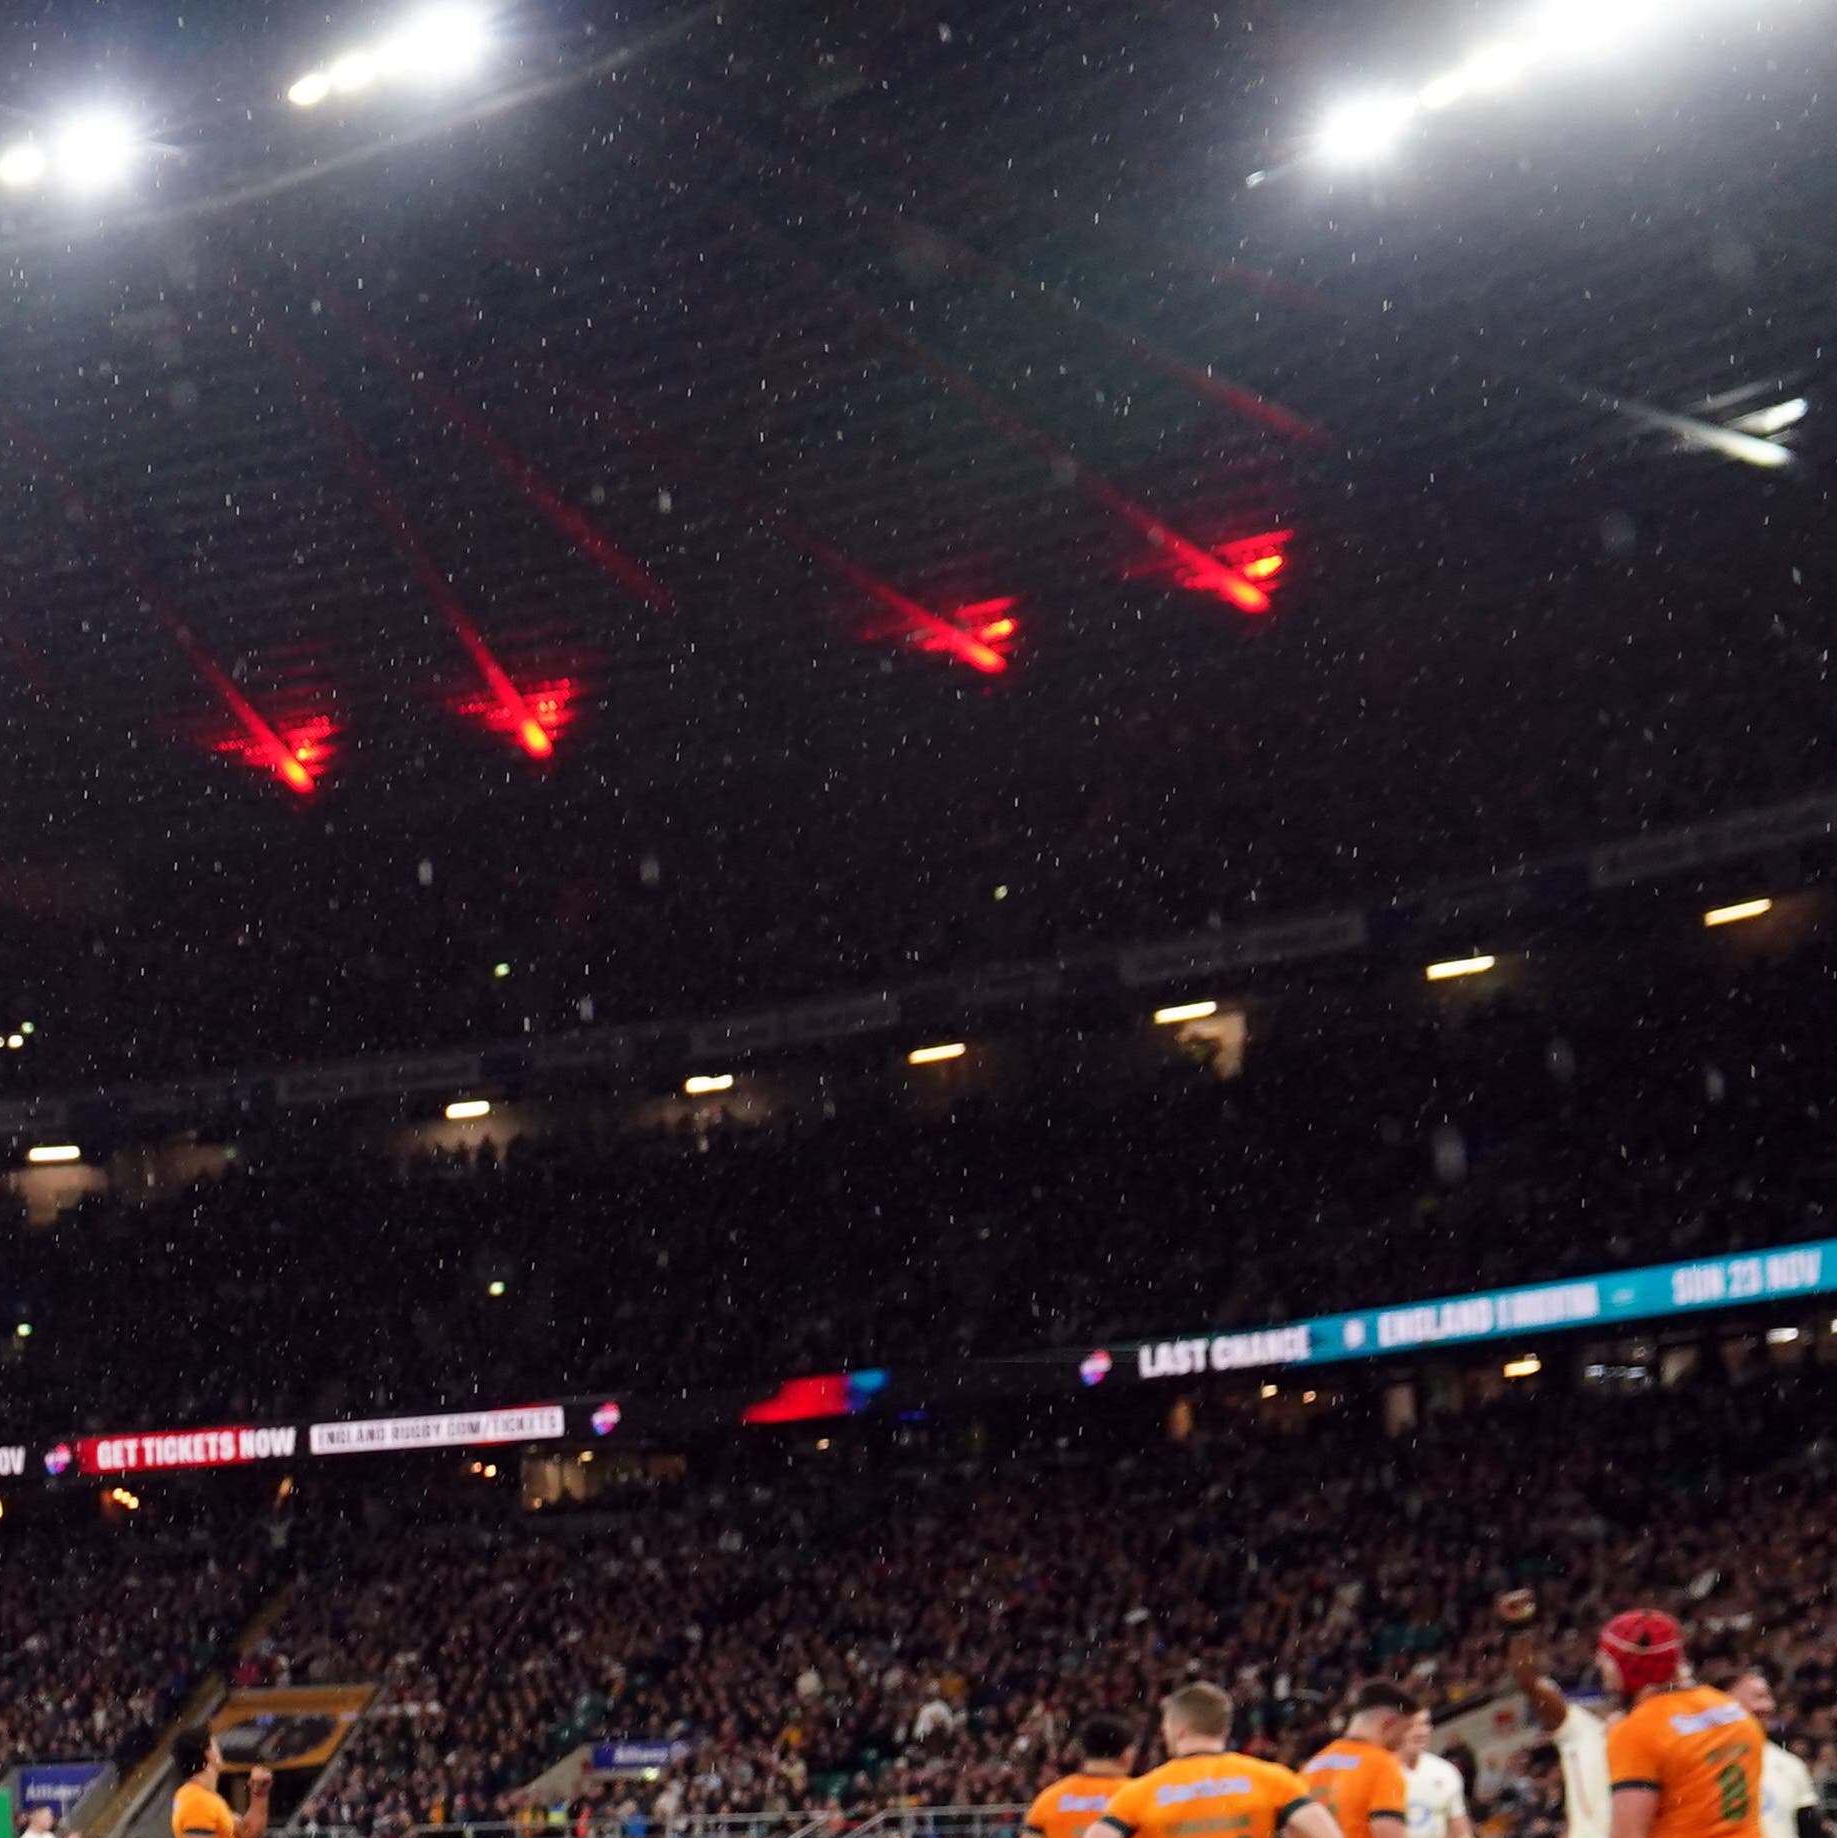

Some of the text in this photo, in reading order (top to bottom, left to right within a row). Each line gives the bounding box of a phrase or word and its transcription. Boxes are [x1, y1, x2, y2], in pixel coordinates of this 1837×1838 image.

[1138, 1338, 1209, 1379] LAST
[96, 1426, 296, 1470] GET TICKETS NOW
